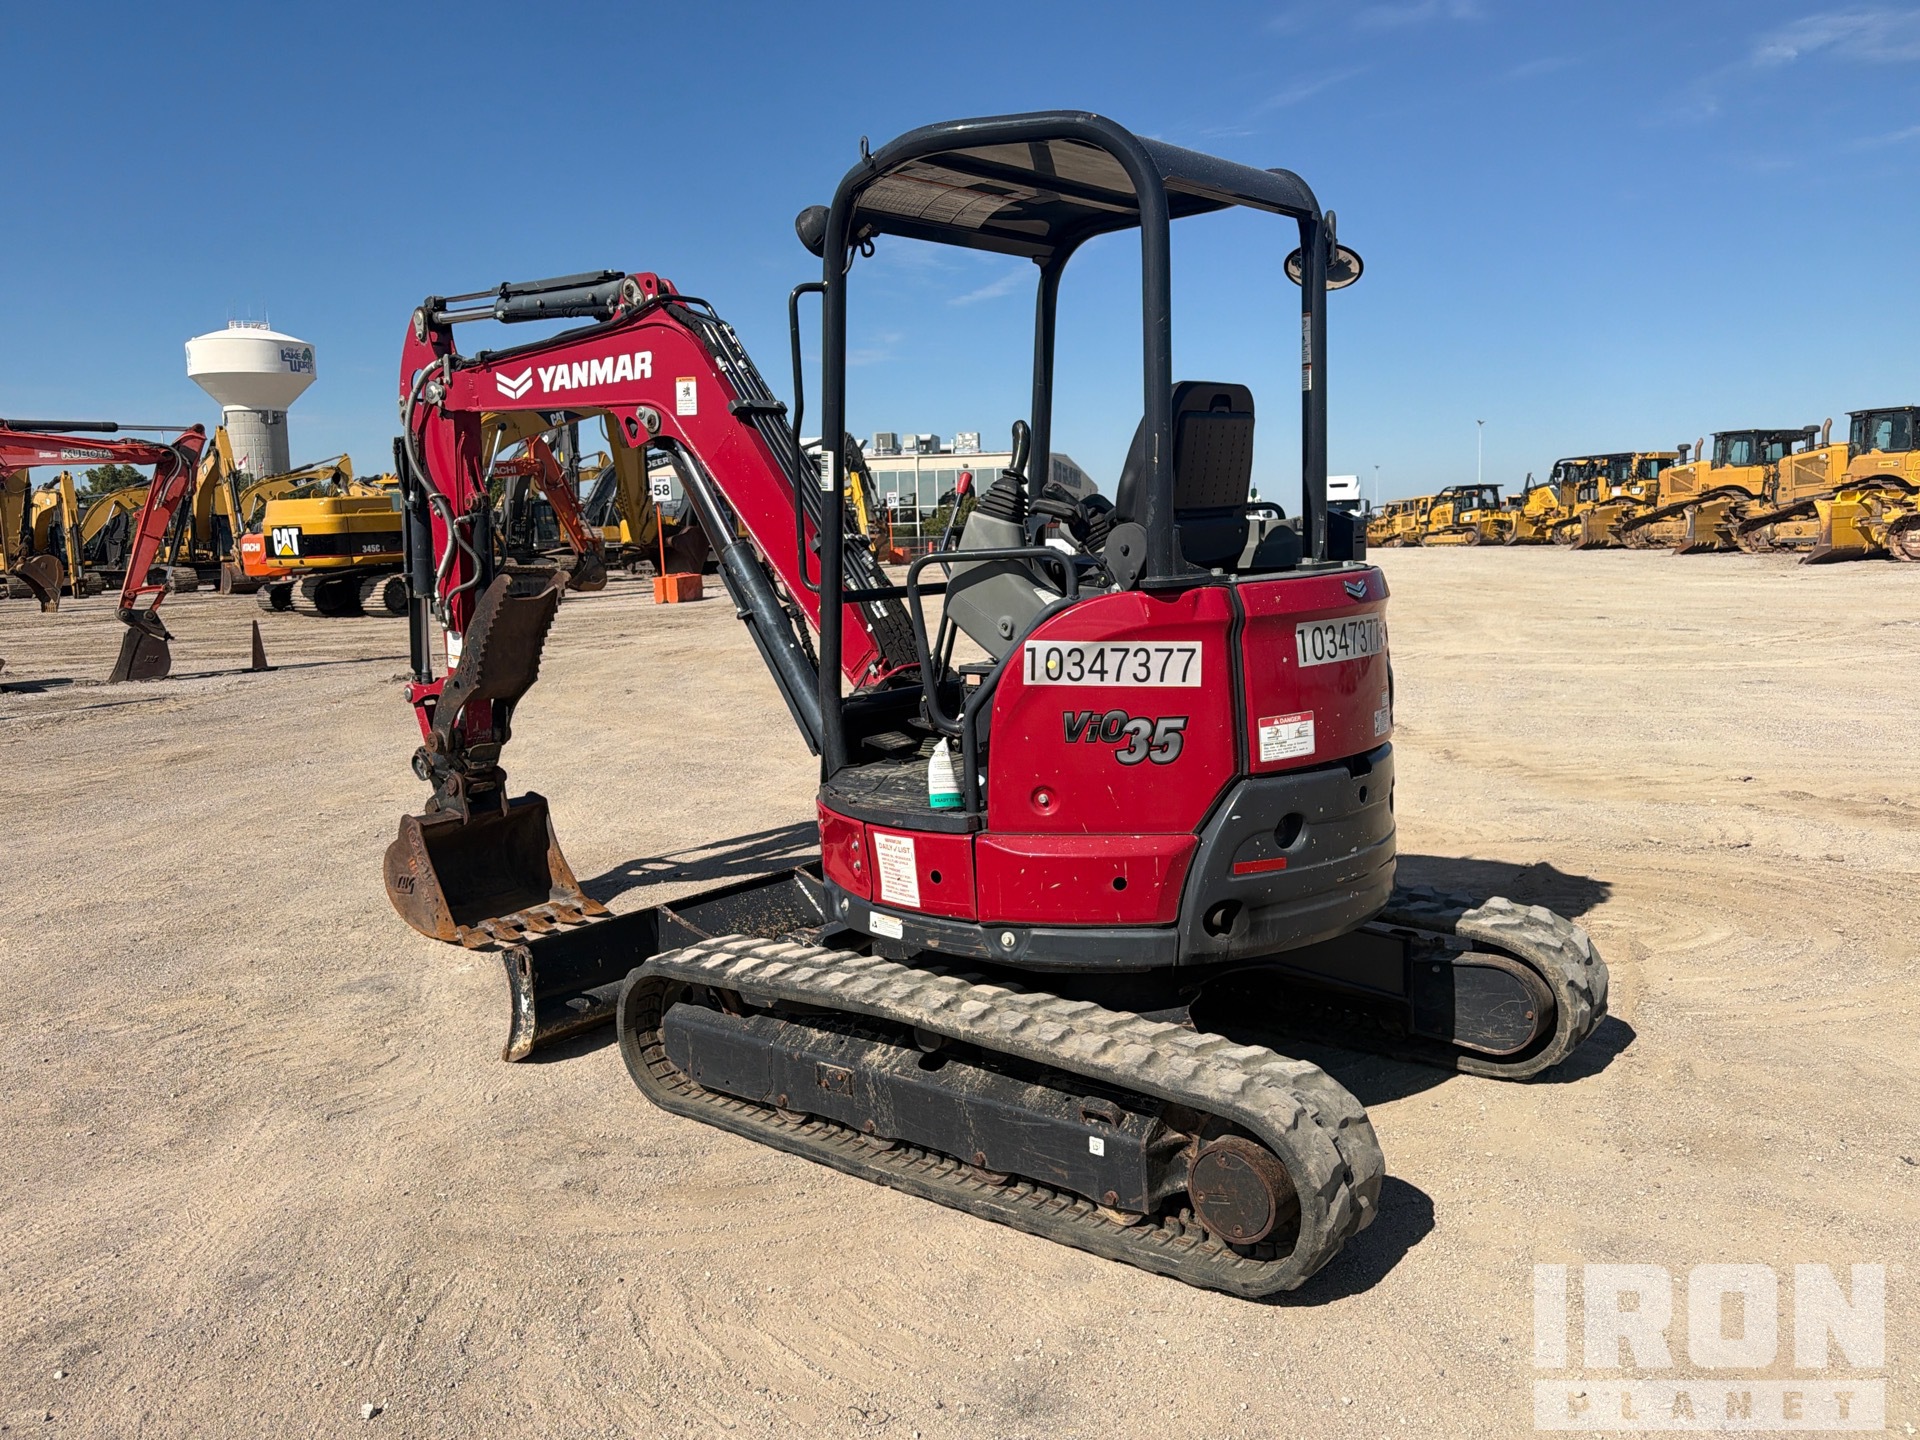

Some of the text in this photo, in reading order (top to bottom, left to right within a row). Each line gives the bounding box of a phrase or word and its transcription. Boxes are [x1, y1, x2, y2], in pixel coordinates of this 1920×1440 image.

[537, 351, 653, 393] YANMAR
[549, 411, 566, 426] CAT
[61, 448, 114, 460] KUBOTA
[647, 457, 670, 468] DEER
[654, 484, 670, 496] 58
[888, 496, 896, 504] 57
[272, 528, 299, 556] CAT
[362, 545, 380, 553] 345C
[1297, 617, 1379, 663] 10347377
[1026, 647, 1197, 683] 10347377
[1279, 715, 1302, 724] DANGER
[878, 842, 911, 854] DAILY LIST
